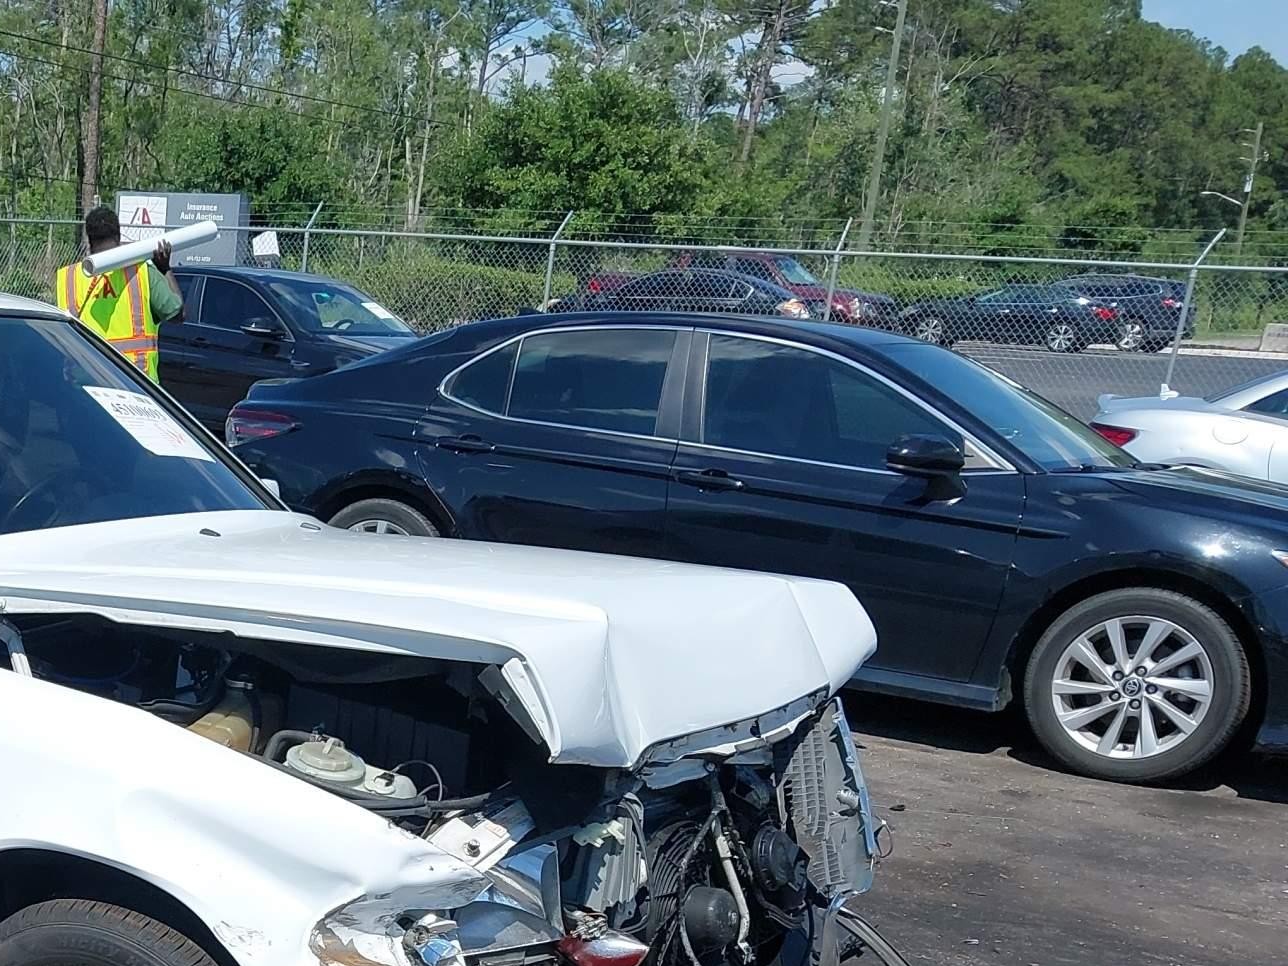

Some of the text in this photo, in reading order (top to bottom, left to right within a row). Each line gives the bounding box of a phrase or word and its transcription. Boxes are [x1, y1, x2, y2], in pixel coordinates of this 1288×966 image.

[186, 202, 218, 211] Insurance
[179, 211, 224, 221] Auto Auctions
